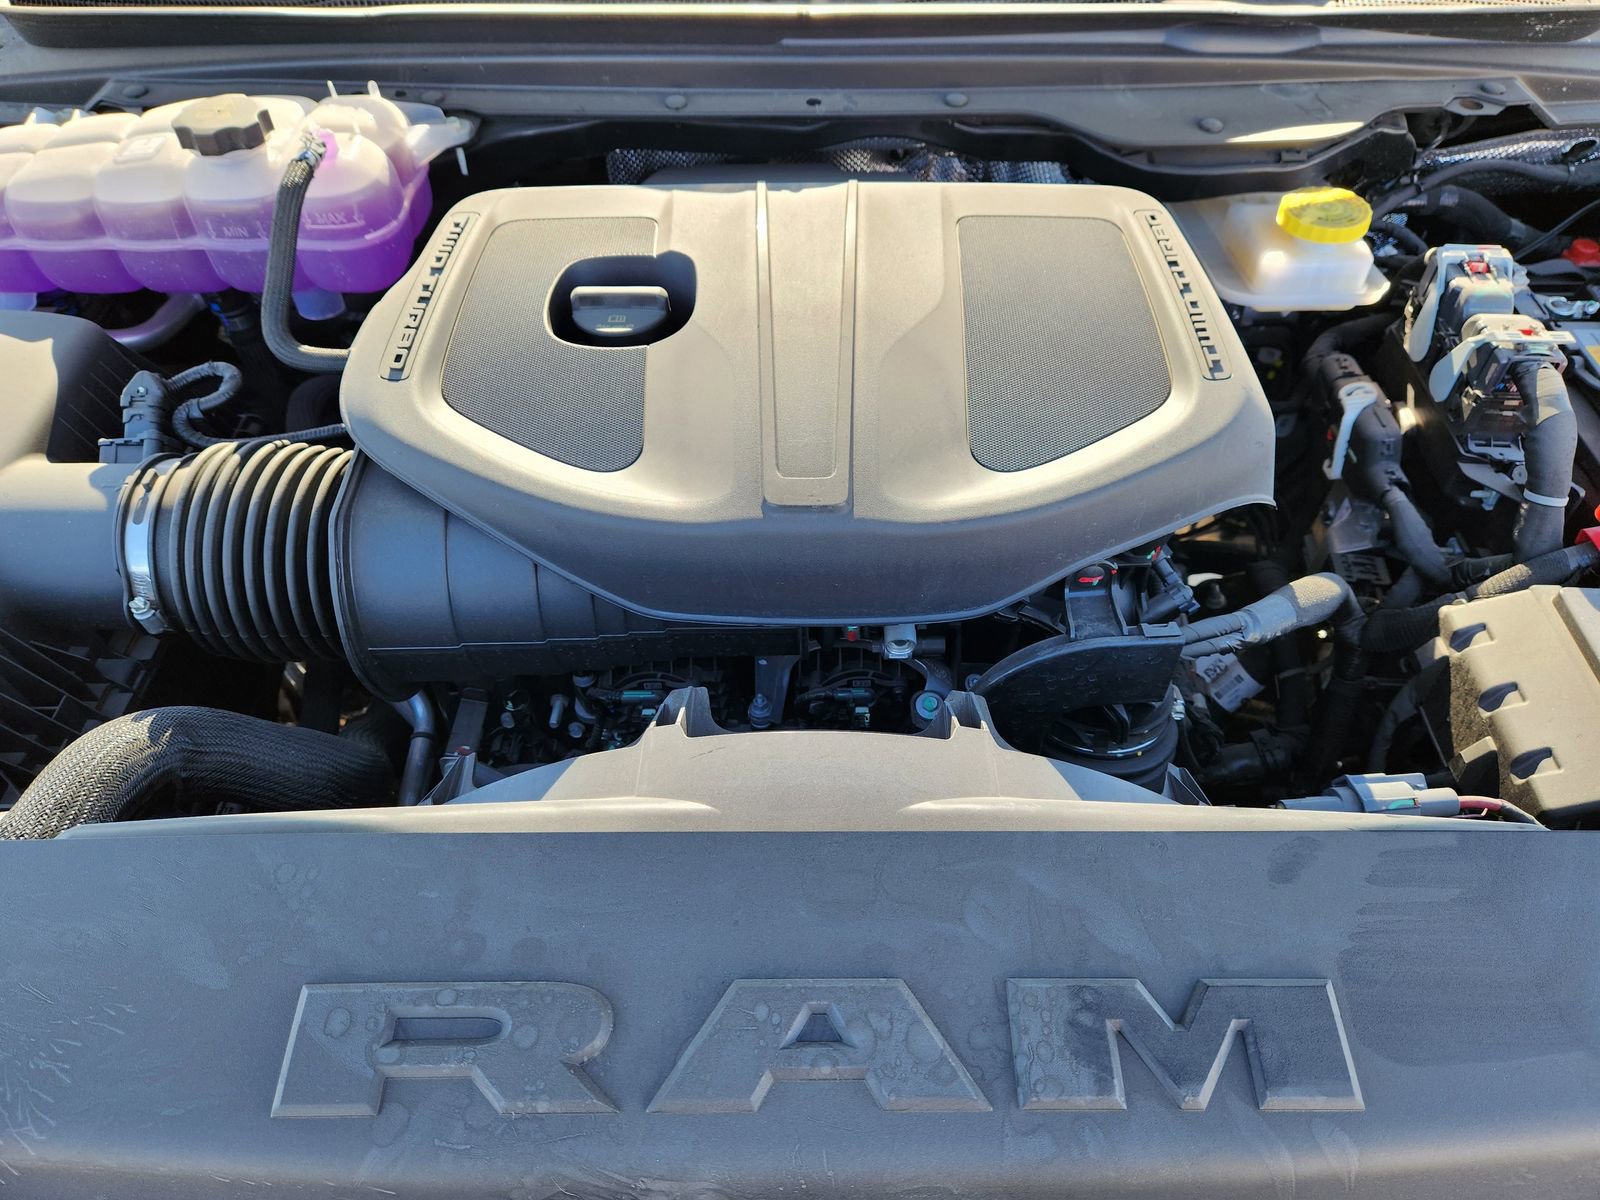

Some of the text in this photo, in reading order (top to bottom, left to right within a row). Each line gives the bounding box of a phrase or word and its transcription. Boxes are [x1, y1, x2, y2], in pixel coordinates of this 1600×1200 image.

[223, 226, 249, 237] MIN
[315, 212, 347, 224] MAX
[389, 216, 470, 370] TWIN TURBO
[1145, 213, 1222, 378] TWIN TURBO
[270, 977, 1366, 1119] RAM
